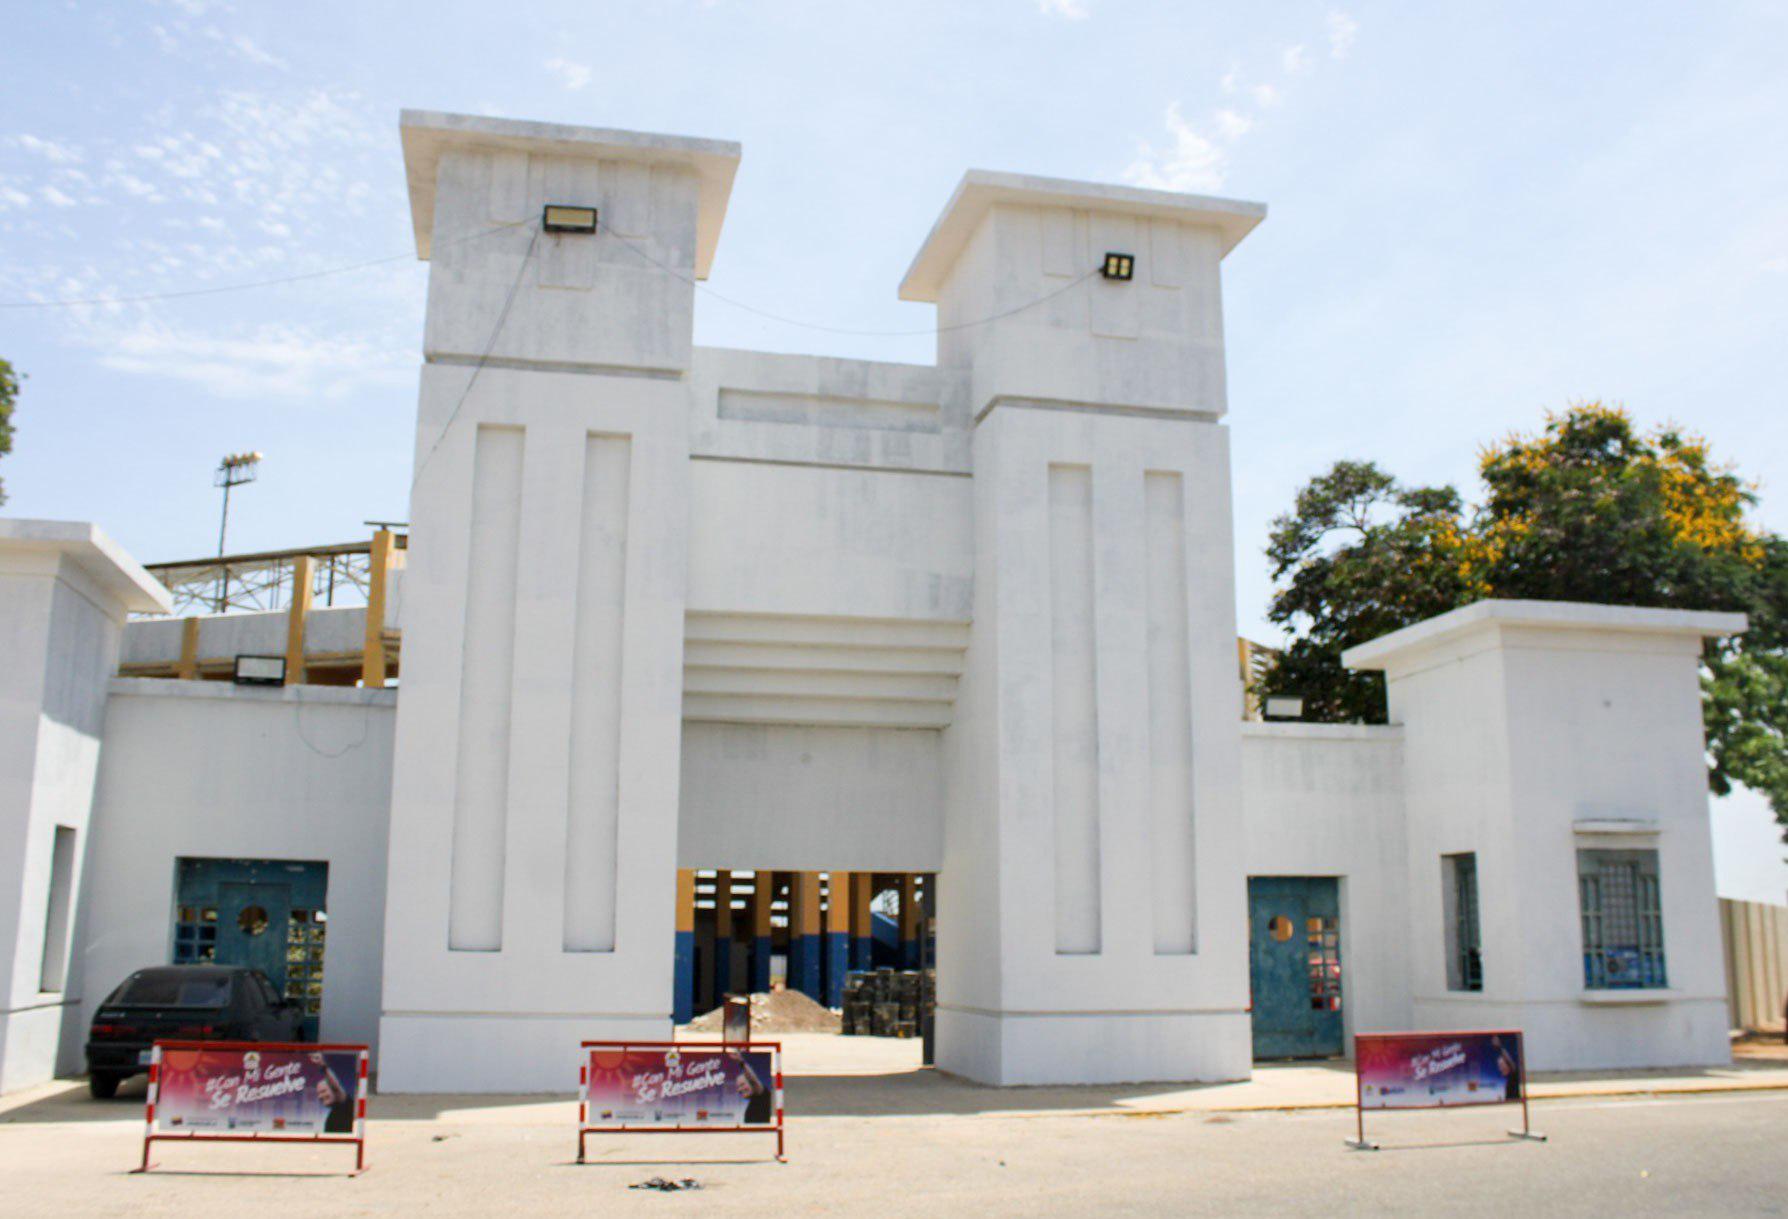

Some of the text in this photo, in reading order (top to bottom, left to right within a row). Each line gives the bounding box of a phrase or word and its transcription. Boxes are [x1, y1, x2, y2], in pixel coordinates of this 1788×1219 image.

[244, 1067, 260, 1083] Mi
[264, 1062, 301, 1079] Gente
[668, 1065, 683, 1079] Mi
[688, 1059, 721, 1075] Gente
[209, 1076, 306, 1110] Se Resuelve
[635, 1072, 725, 1104] Se Resuelve
